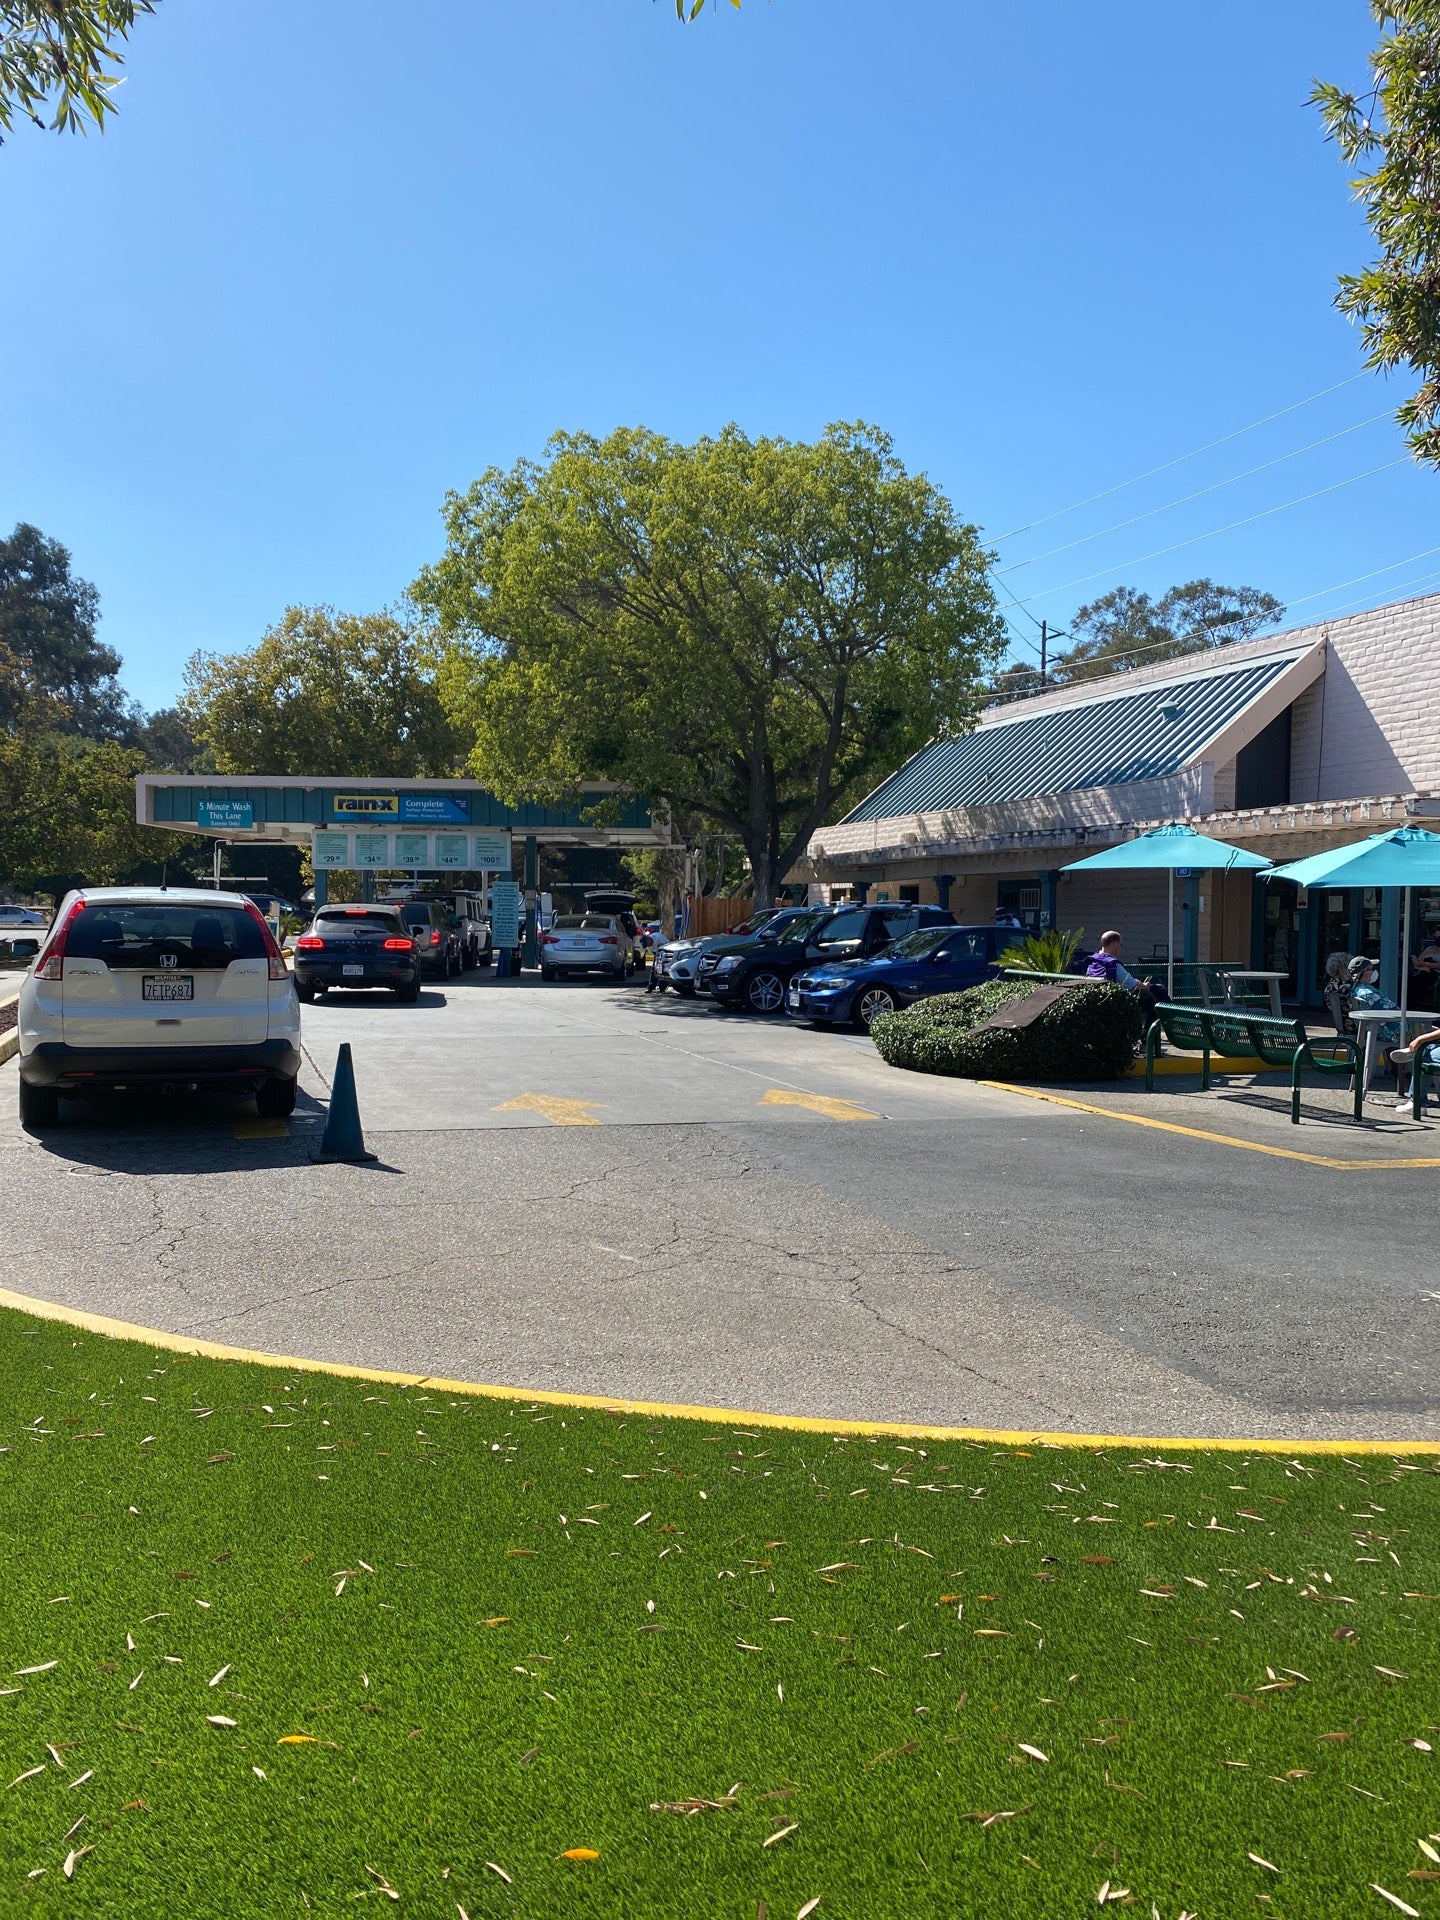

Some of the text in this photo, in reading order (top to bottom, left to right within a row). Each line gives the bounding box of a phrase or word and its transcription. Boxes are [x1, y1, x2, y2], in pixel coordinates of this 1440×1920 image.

[199, 802, 251, 811] 5 Minute Wash
[405, 800, 444, 809] Complete
[209, 811, 241, 820] This Lane
[145, 984, 190, 996] 7FTP687
